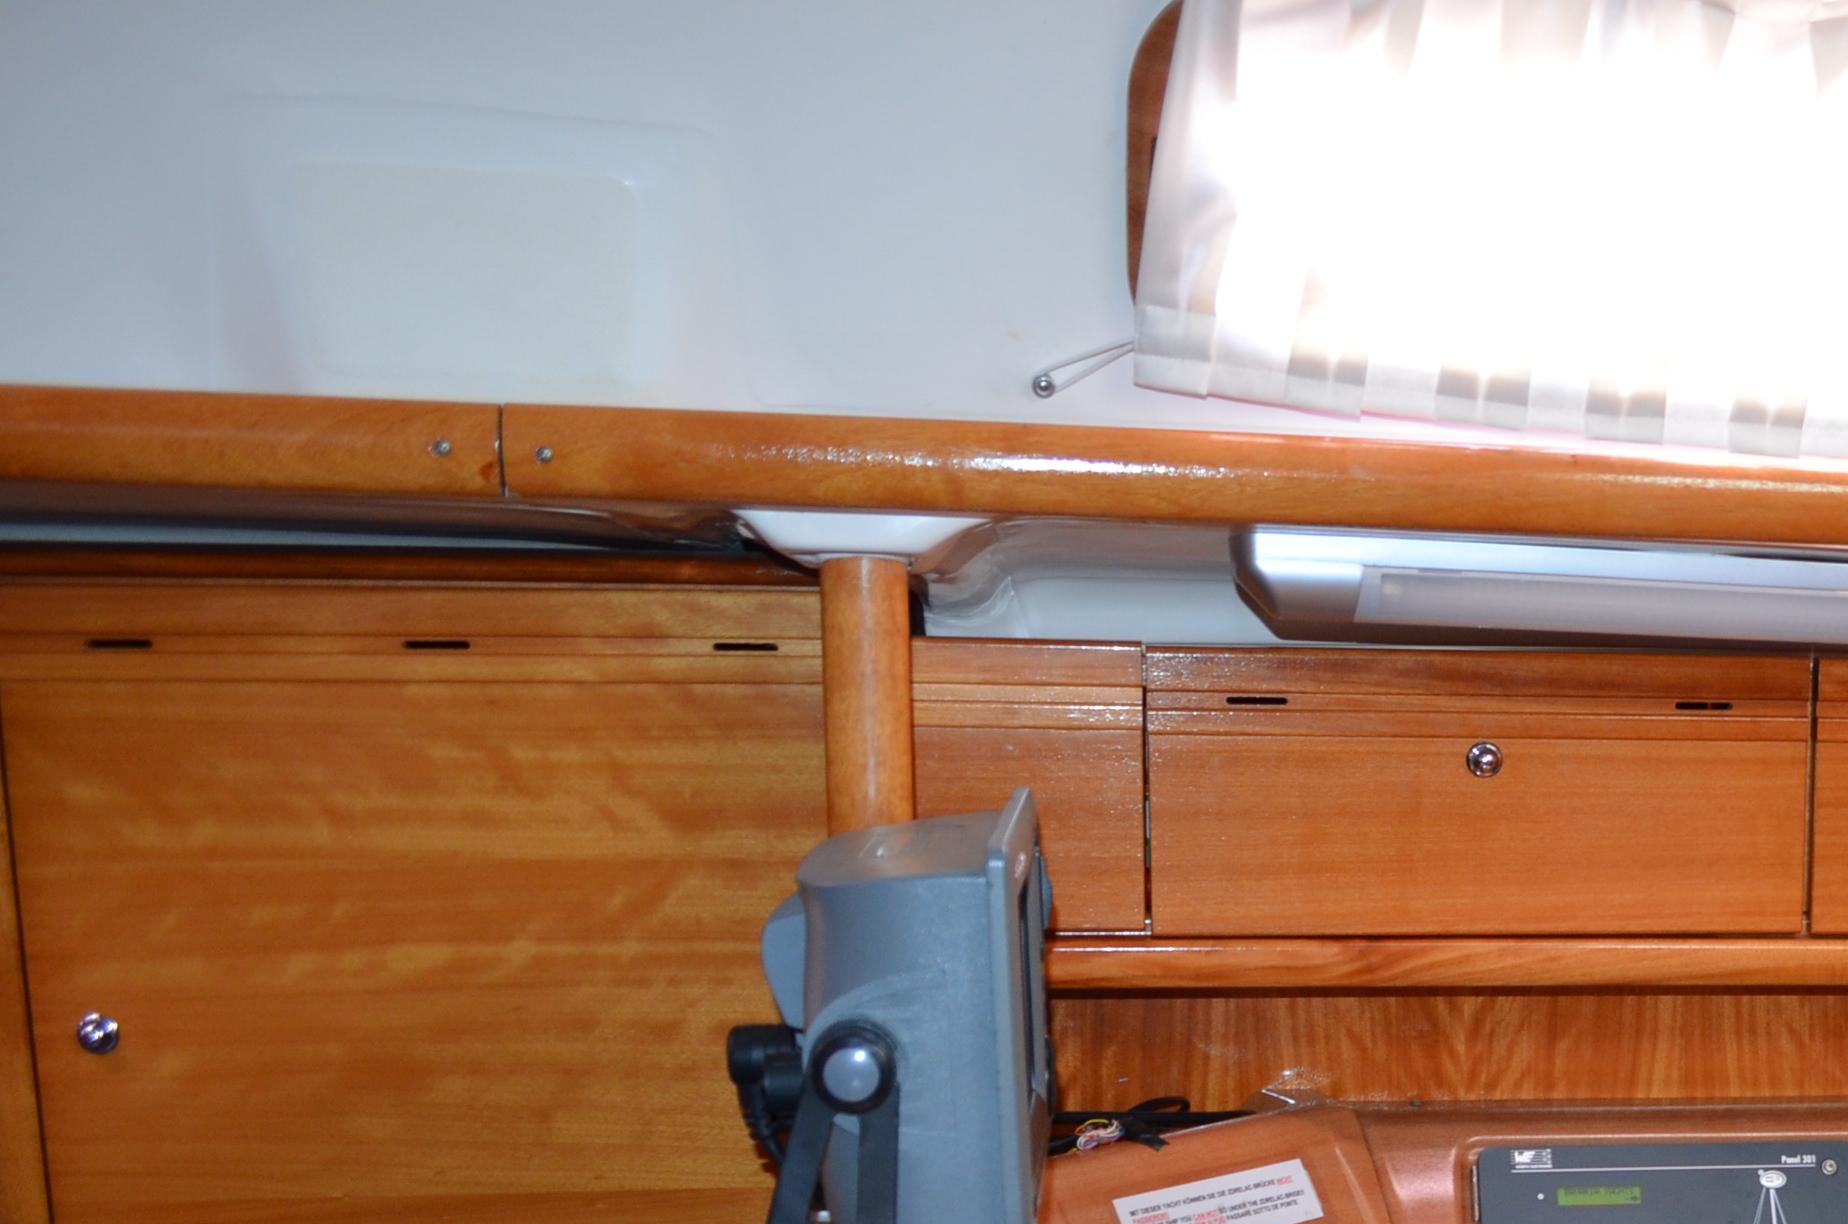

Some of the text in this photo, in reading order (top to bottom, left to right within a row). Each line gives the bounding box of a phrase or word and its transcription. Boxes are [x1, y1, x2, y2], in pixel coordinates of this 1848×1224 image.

[1781, 1154, 1816, 1164] Panel 301
[1141, 1205, 1162, 1215] DIESER
[1163, 1200, 1183, 1210] YACHT
[1182, 1194, 1207, 1205] KÖNNEN
[1227, 1210, 1252, 1221] PASSARE
[1253, 1206, 1271, 1215] SOTTO
[1280, 1200, 1298, 1209] PONTE
[1229, 1203, 1247, 1212] UNDER
